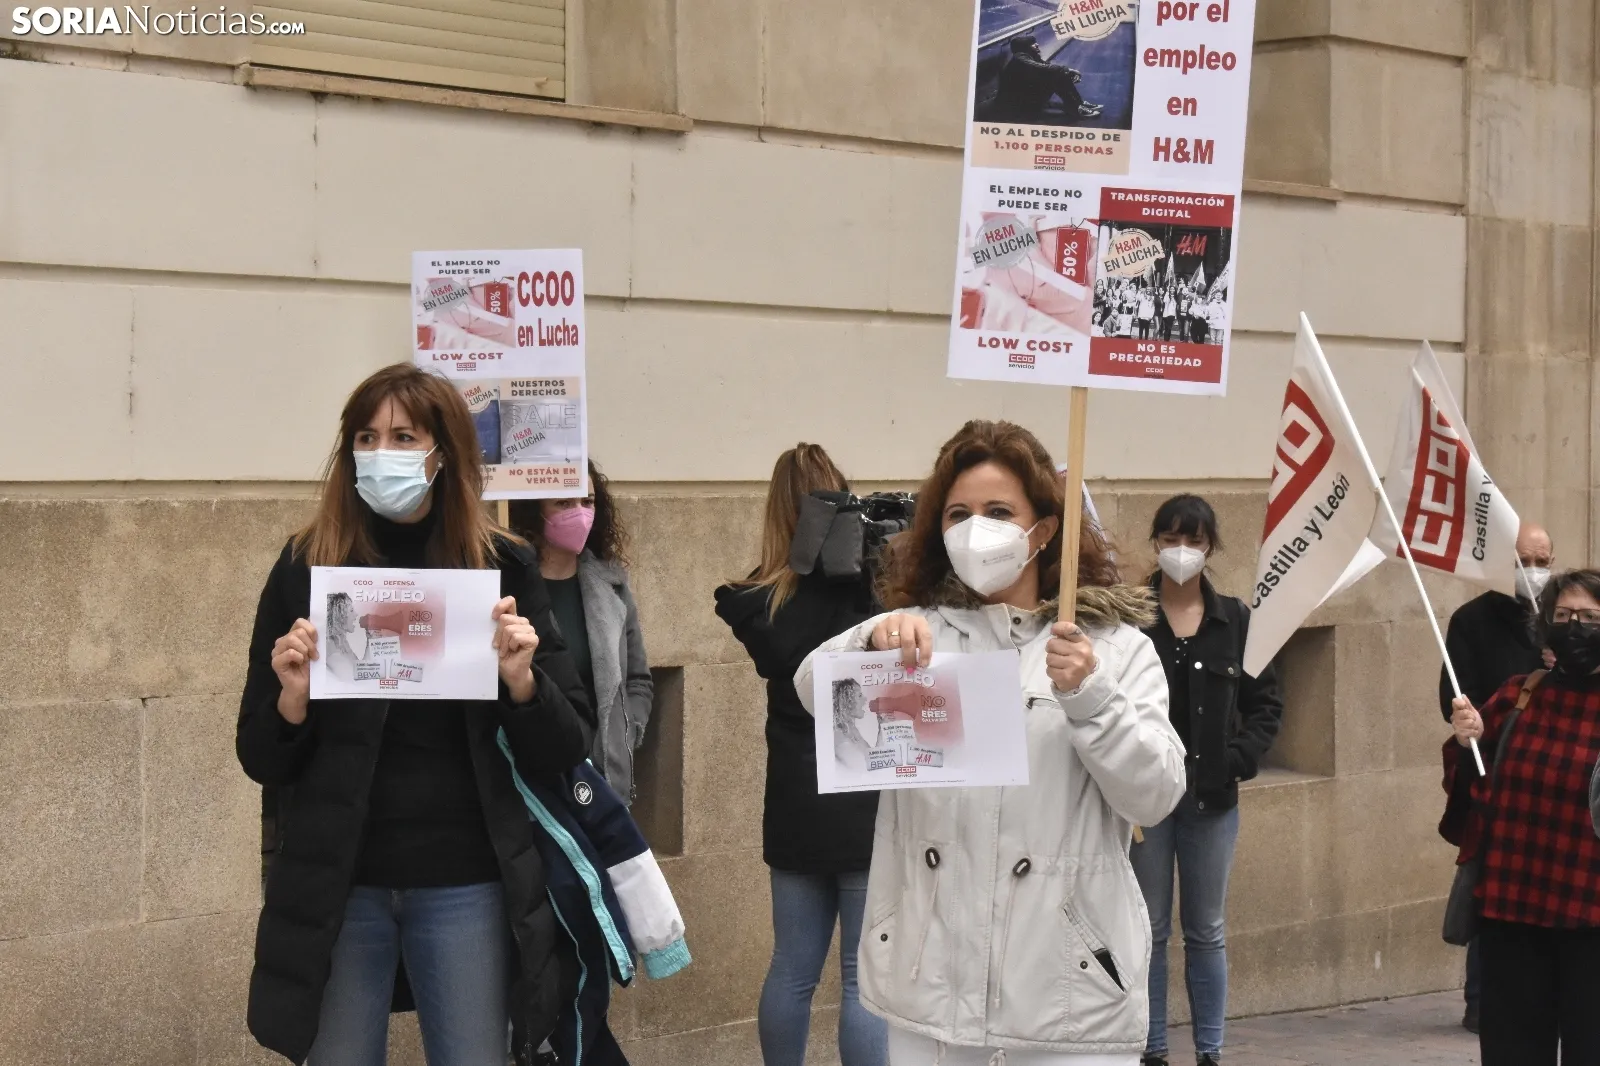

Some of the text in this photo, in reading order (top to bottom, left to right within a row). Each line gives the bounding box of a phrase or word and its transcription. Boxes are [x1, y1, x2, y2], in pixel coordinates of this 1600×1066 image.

[1069, 0, 1103, 15] H&M
[1157, 0, 1229, 26] por el
[1056, 4, 1127, 35] EN LUCHA
[1143, 44, 1237, 75] empleo
[1167, 97, 1197, 116] en
[980, 126, 1121, 142] NO AL DESPIDO DE
[994, 140, 1114, 156] 1.100 PERSONAS
[1152, 137, 1215, 165] H&M
[1036, 156, 1064, 164] CCOO
[989, 185, 1083, 199] EL EMPLEO NO
[1110, 192, 1225, 207] TRANSFORMACIÓN
[998, 200, 1068, 212] PUEDE SER
[1142, 207, 1191, 219] DIGITAL
[984, 224, 1016, 244] H&M
[972, 232, 1035, 264] EN LUCHA
[1115, 236, 1143, 254] H&M
[1062, 241, 1079, 277] 50%
[1104, 244, 1160, 273] EN LUCHA
[431, 284, 454, 298] H&M
[517, 271, 575, 307] CCOO
[423, 288, 469, 311] EN LUCHA
[491, 291, 501, 314] 50%
[517, 317, 579, 347] en Lucha
[978, 337, 1073, 354] LOW COST
[1137, 343, 1176, 354] NO ES
[432, 352, 503, 361] LOW COST
[1010, 355, 1034, 363] CCOO
[1109, 352, 1202, 367] PRECARIEDAD
[464, 385, 481, 399] H&M
[469, 390, 494, 406] LUCHA
[513, 427, 532, 442] H&M
[506, 432, 545, 456] EN LUCHA
[527, 466, 559, 475] ESTÁN
[563, 467, 576, 475] EN
[1303, 518, 1323, 541] y
[1313, 474, 1350, 522] León
[1472, 492, 1492, 561] Castilla
[353, 589, 426, 603] EMPLEO
[409, 610, 433, 622] NO
[408, 624, 432, 632] ERES
[357, 671, 381, 679] BBVA
[861, 671, 936, 688] EMPLEO
[920, 694, 946, 708] NO
[921, 710, 947, 718] ERES
[870, 759, 896, 769] BBVA
